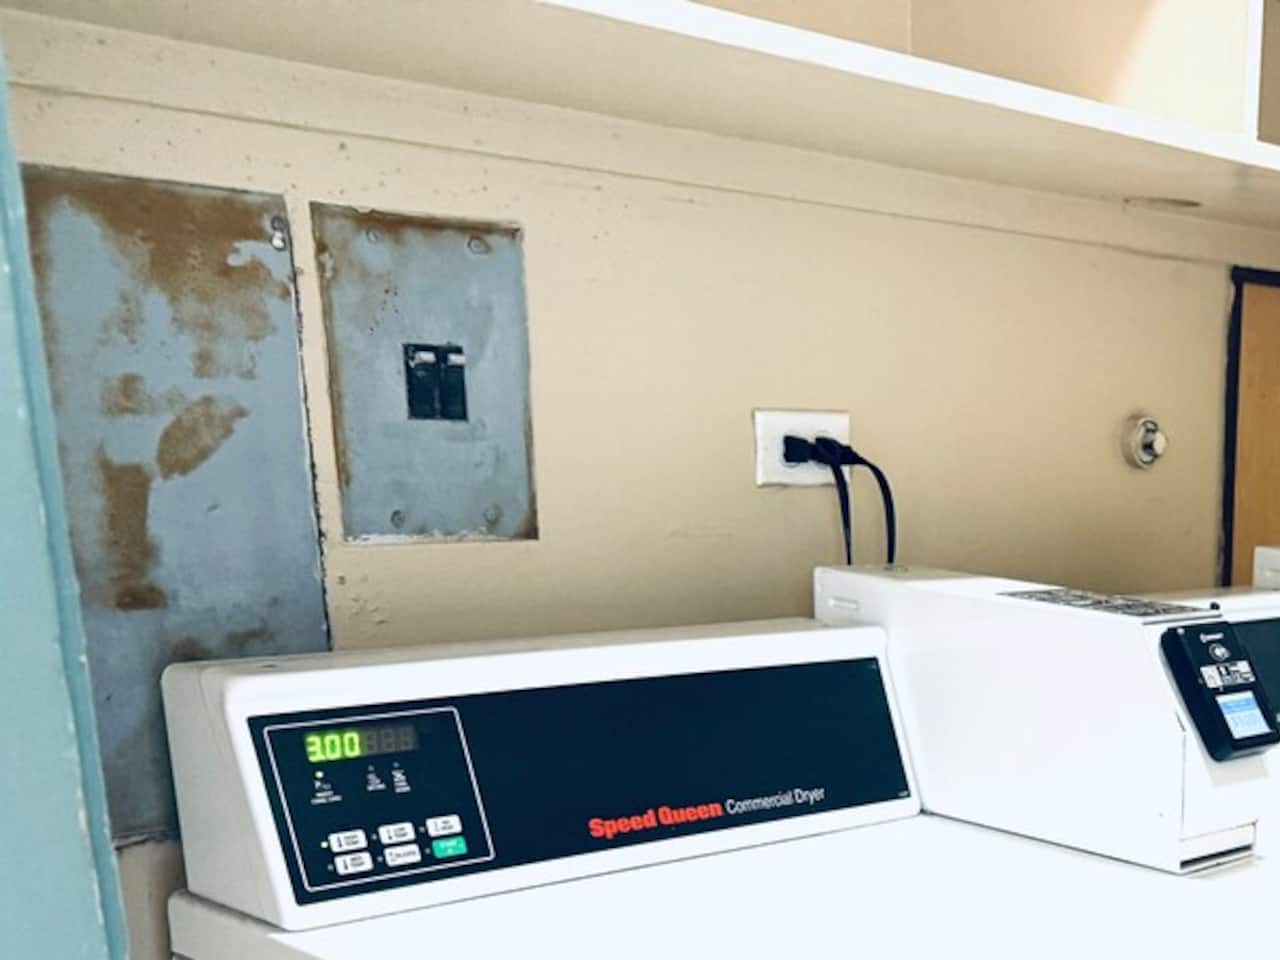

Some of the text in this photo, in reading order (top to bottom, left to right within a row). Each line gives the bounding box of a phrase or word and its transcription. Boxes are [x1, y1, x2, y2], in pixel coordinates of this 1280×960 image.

[588, 787, 826, 840] Speed Queen Commercial Dryer
